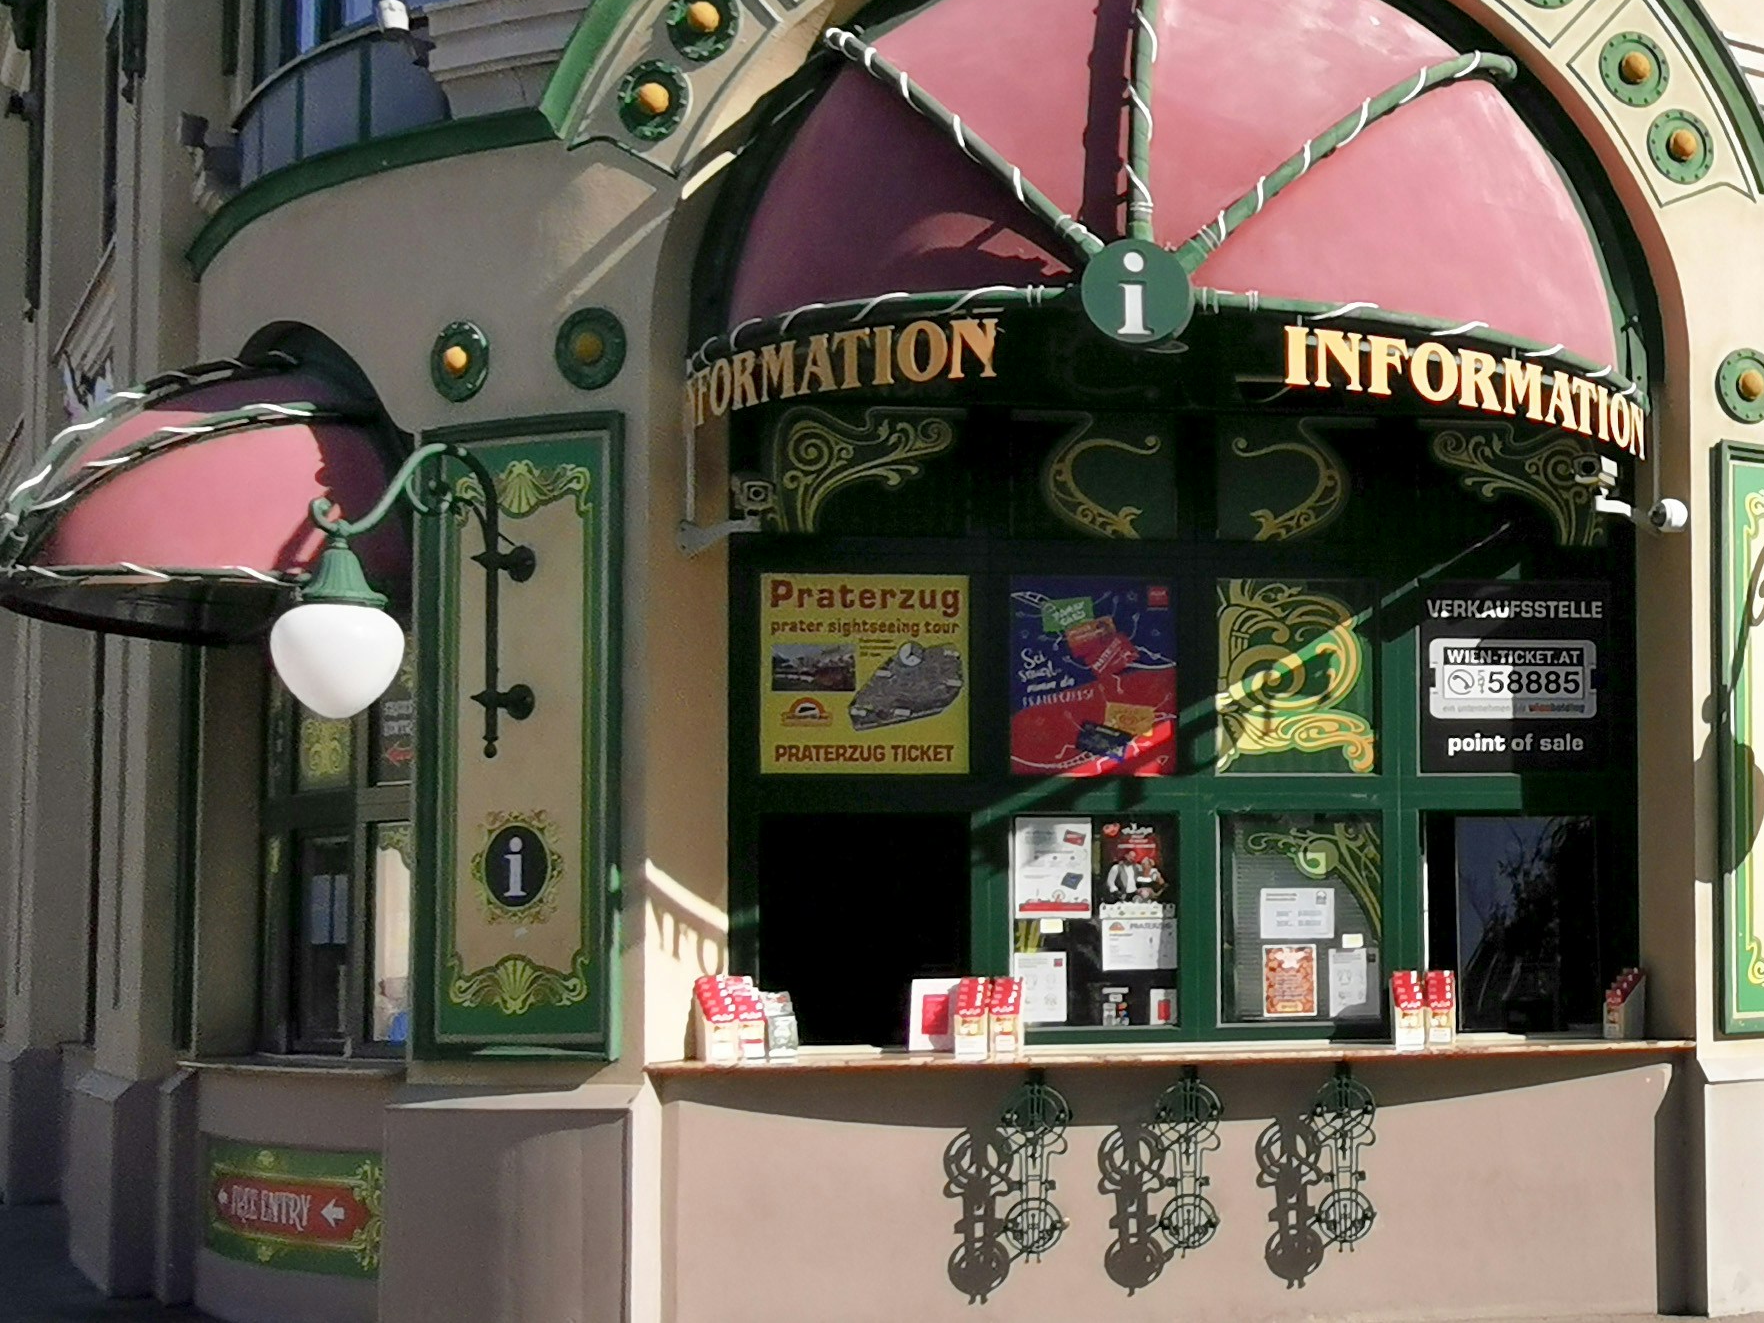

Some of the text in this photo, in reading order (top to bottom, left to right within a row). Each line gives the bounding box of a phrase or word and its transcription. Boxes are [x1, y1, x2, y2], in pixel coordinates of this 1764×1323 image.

[1284, 325, 1648, 461] INFORMATION
[770, 580, 961, 618] Praterzug
[1426, 598, 1603, 620] VERKAUFSSTELLE
[770, 618, 960, 638] prater sightseeing tour
[1446, 649, 1581, 665] WIEN-TICKET.AT
[1487, 670, 1581, 695] 58885
[774, 745, 955, 764] PRATERZUG TICKET
[1446, 733, 1585, 757] point of sale
[260, 1190, 312, 1232] ENTRY
